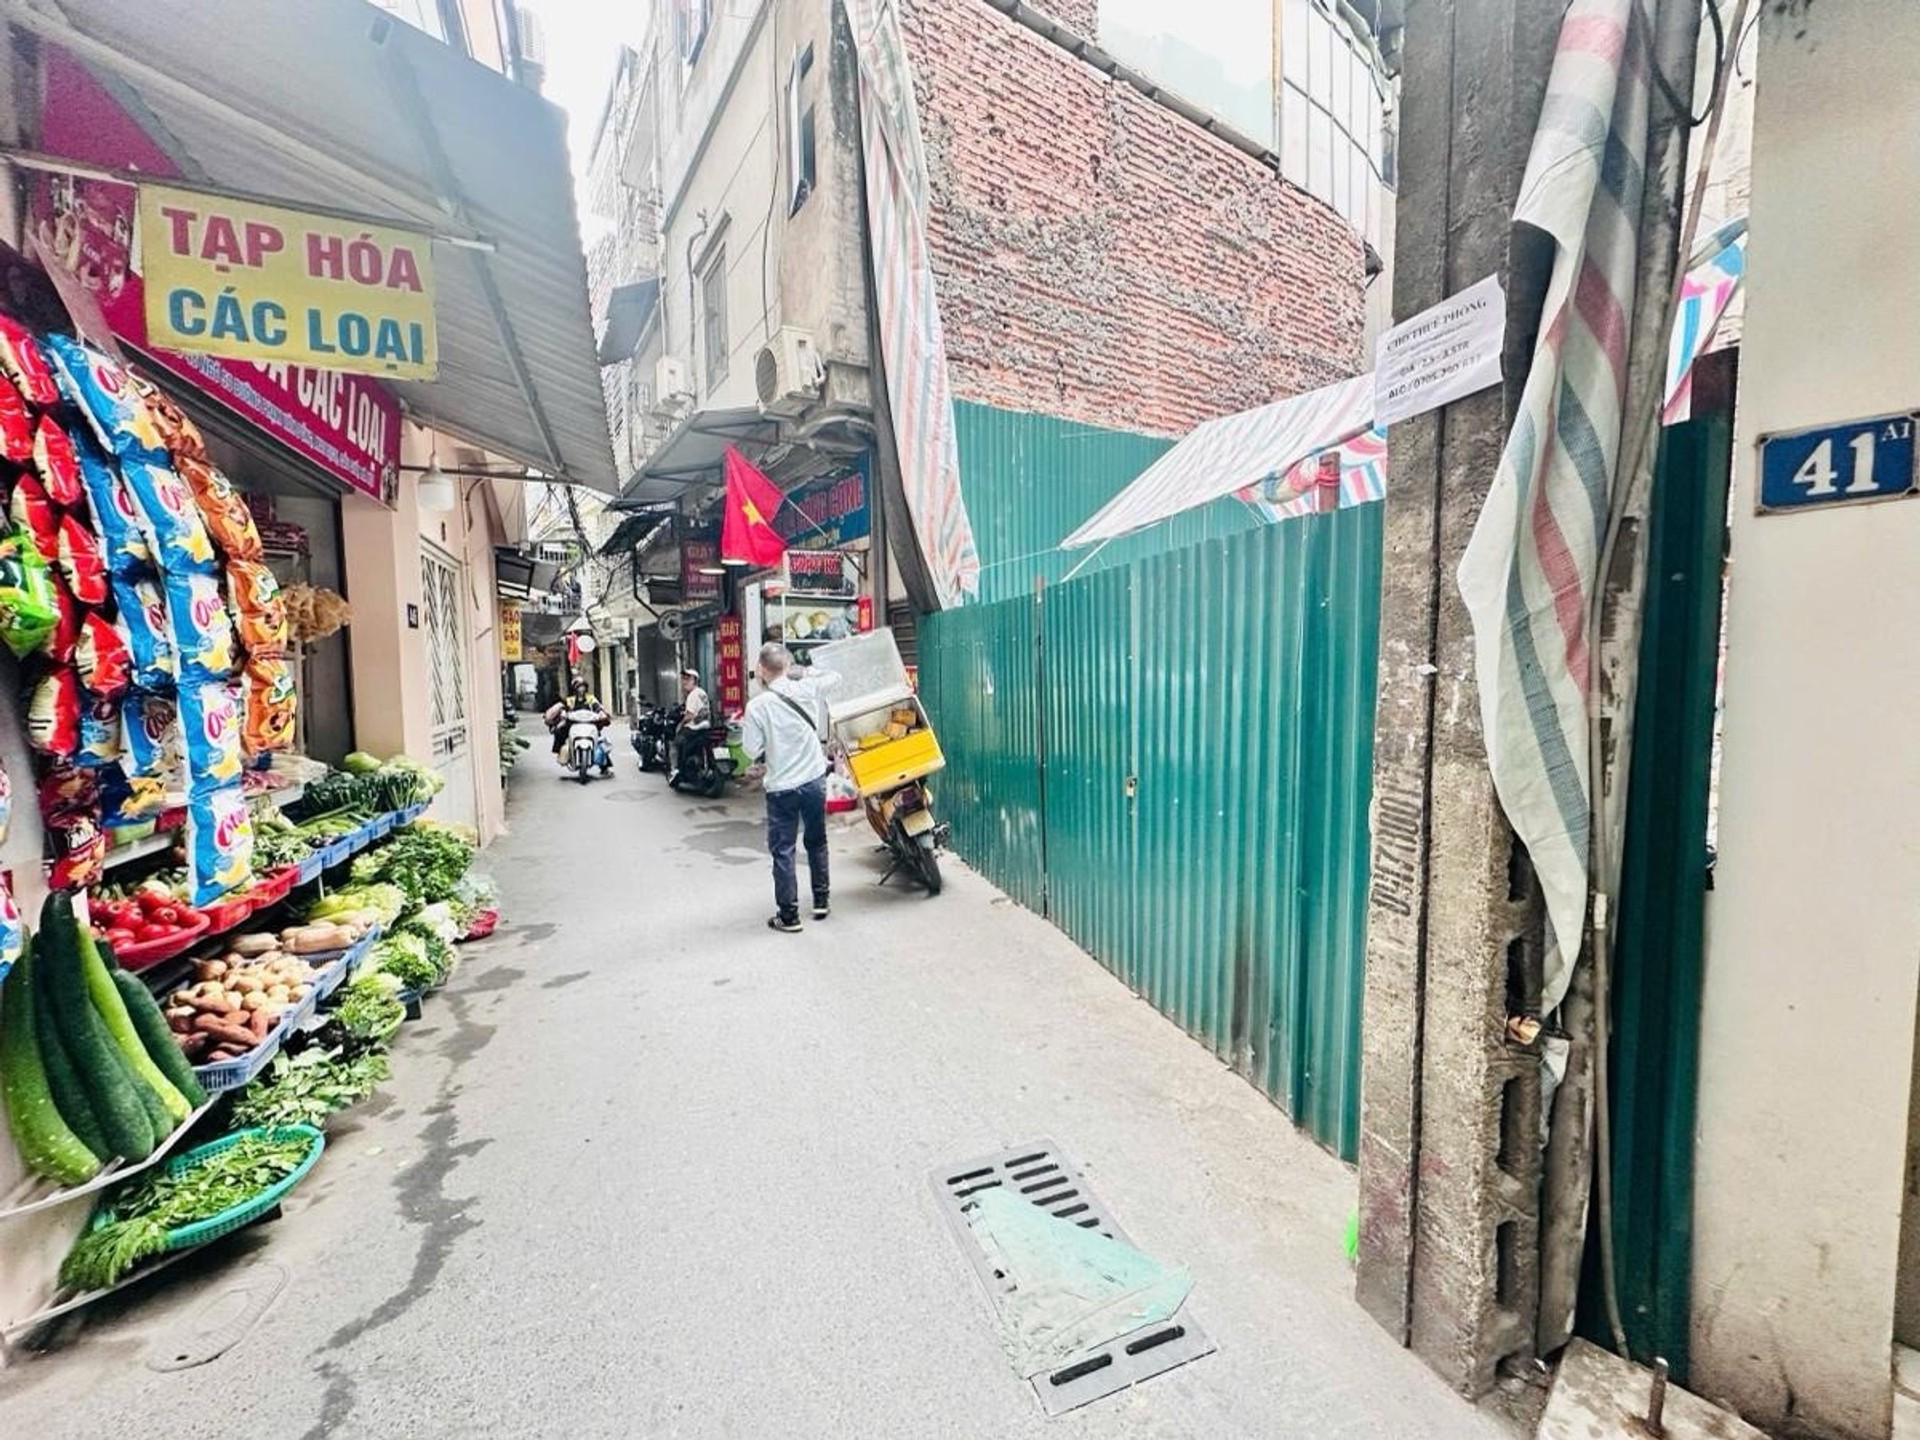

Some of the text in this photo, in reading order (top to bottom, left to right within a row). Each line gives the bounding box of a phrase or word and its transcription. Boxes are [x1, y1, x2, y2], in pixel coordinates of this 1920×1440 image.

[161, 206, 424, 293] TẠP HÓA
[168, 287, 425, 370] CÁC LOẠI
[1793, 422, 1911, 496] 41 A1
